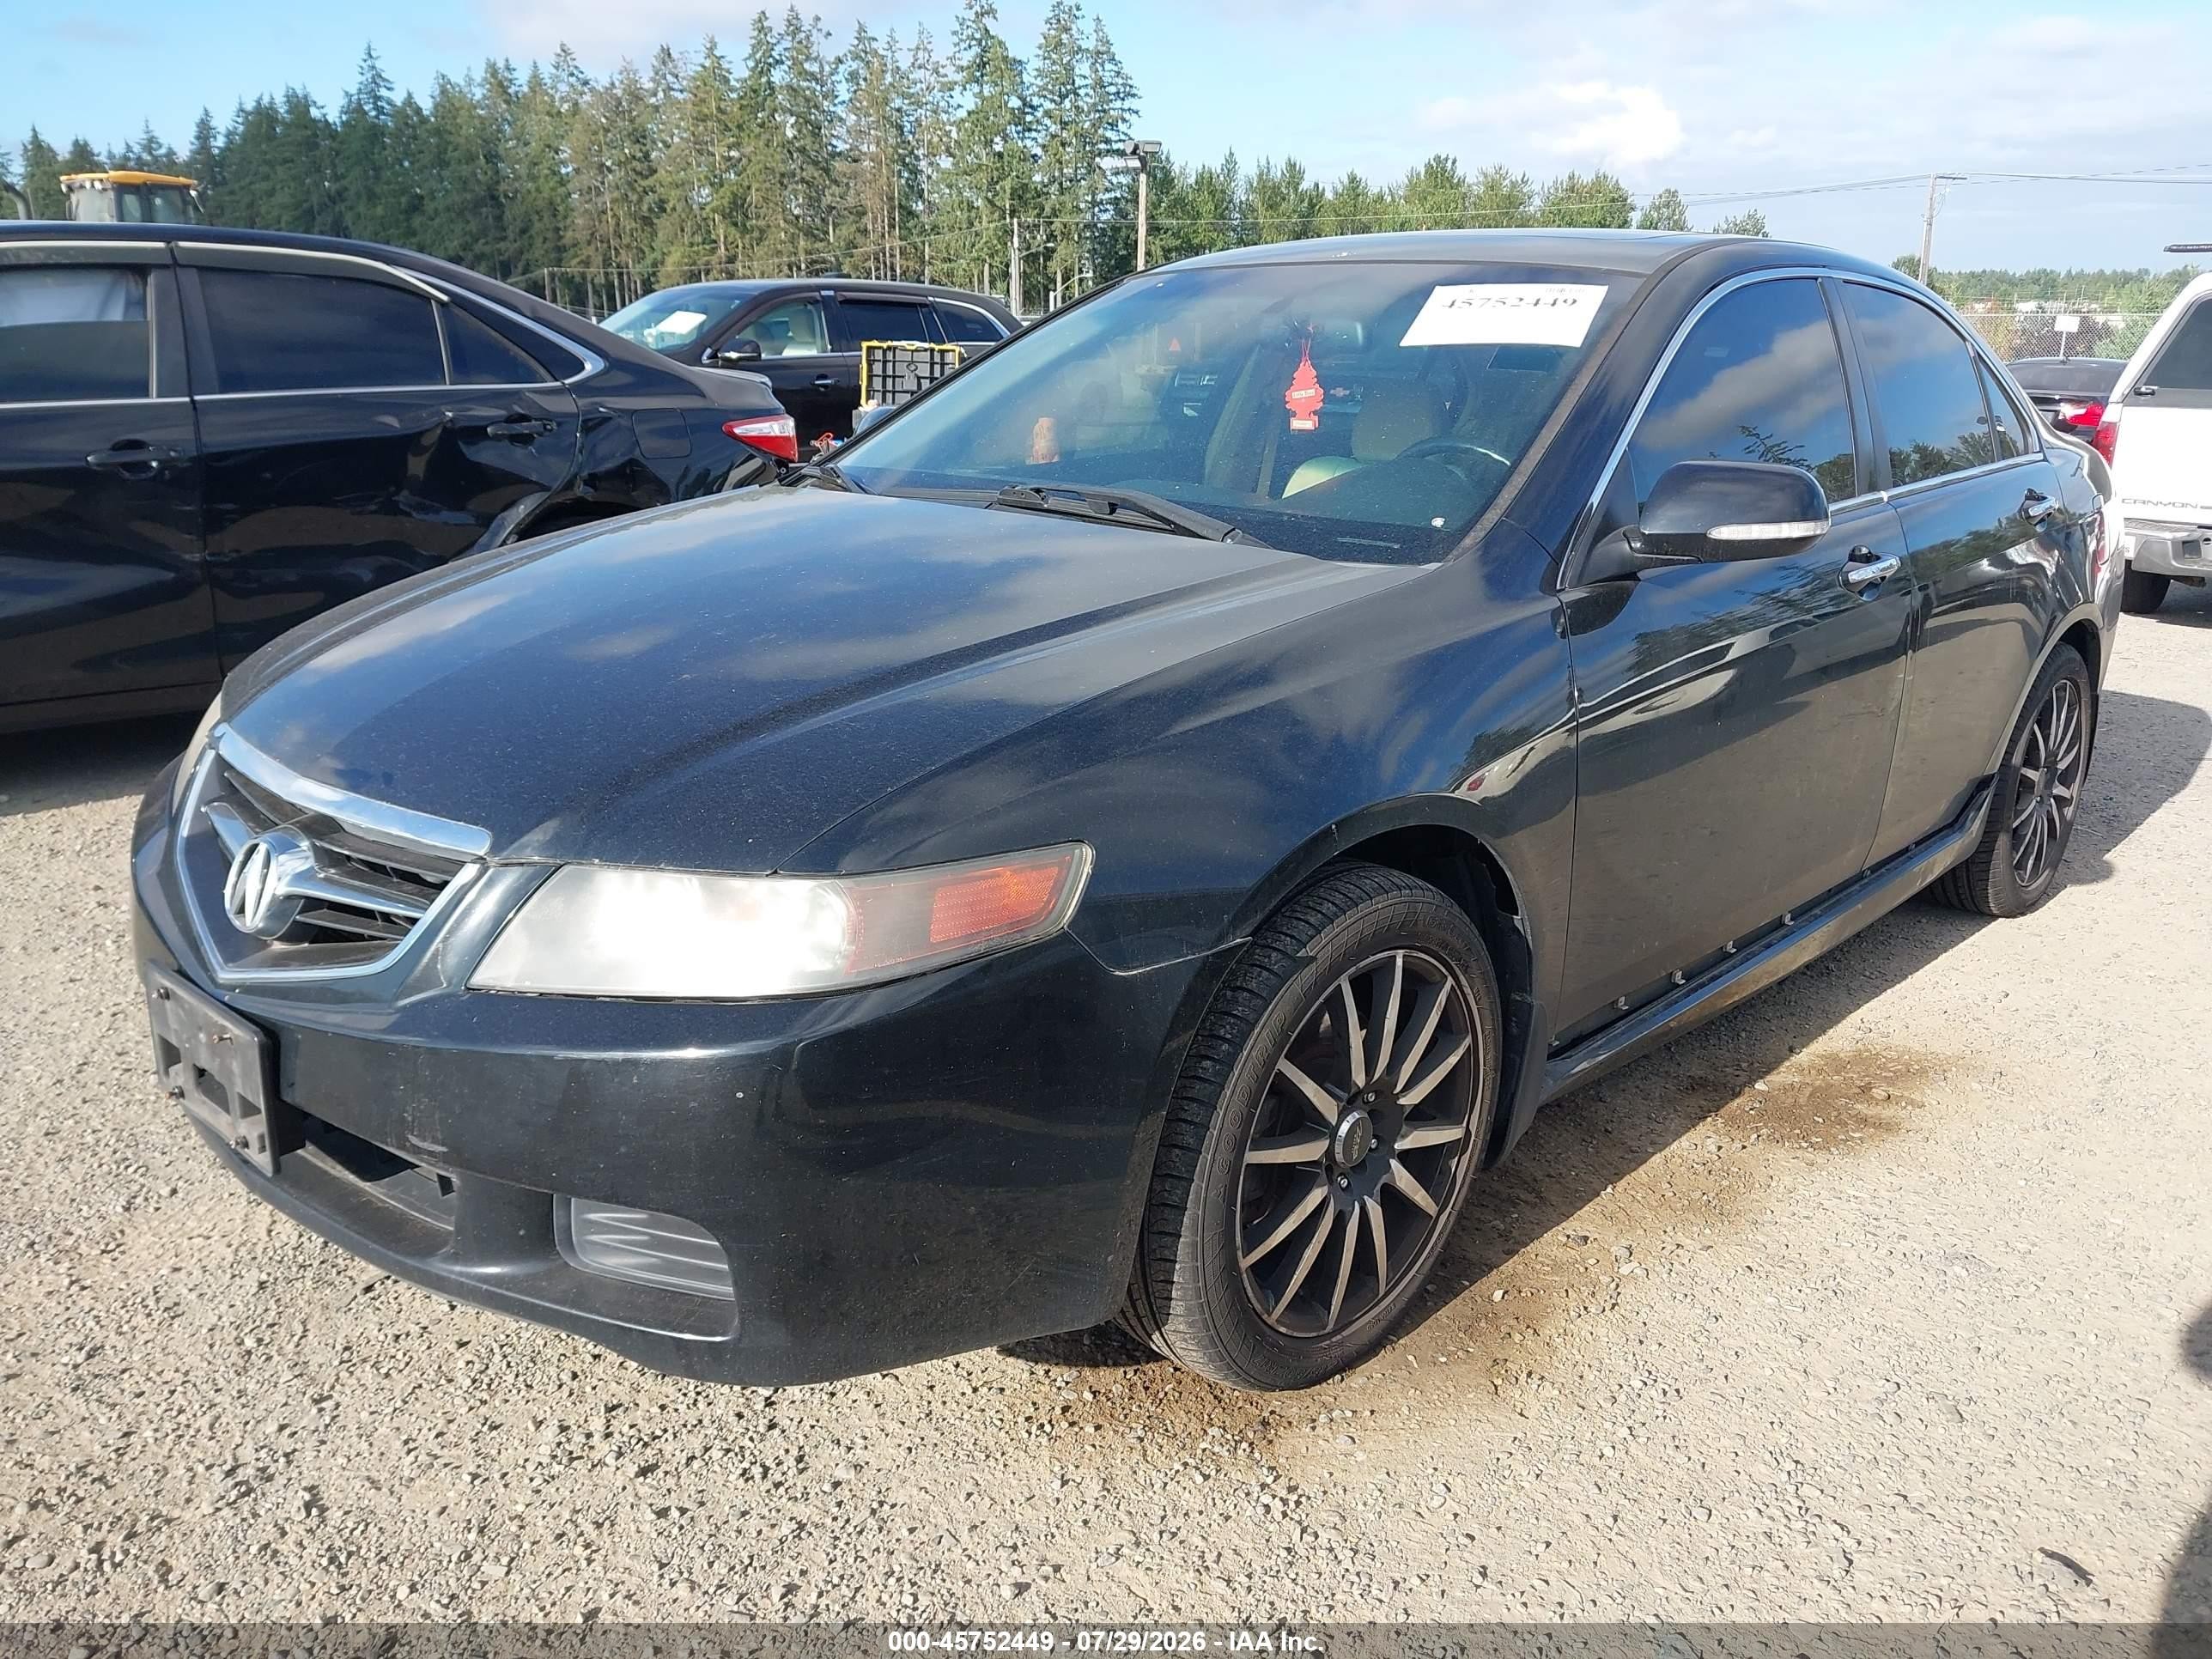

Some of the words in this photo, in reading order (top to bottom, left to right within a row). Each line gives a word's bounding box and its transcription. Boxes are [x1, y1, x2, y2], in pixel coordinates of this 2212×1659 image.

[1442, 296, 1578, 309] 45752449
[2121, 498, 2198, 509] CANYON
[1215, 1009, 1286, 1176] GOODTRIP
